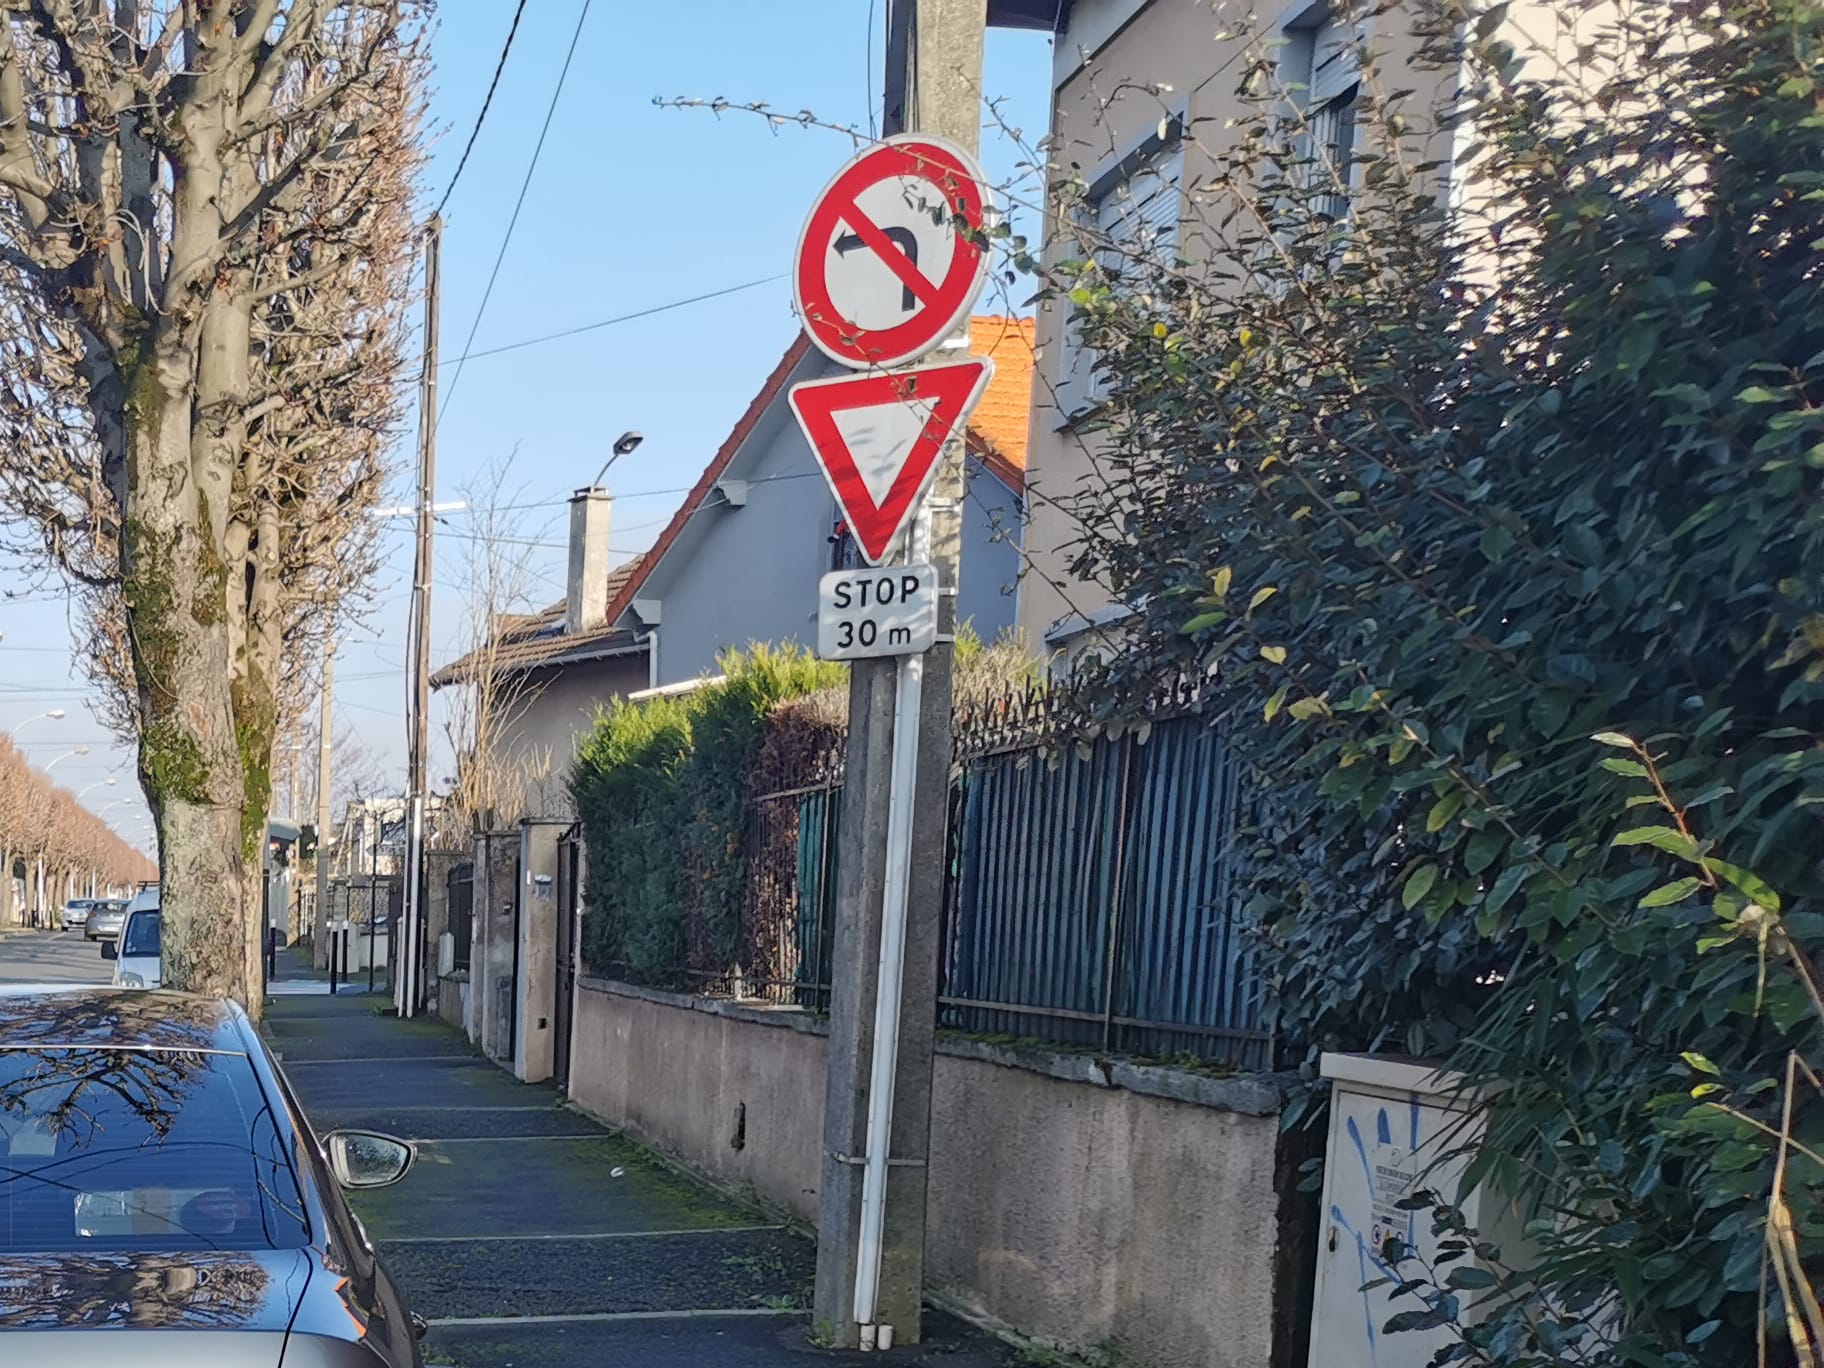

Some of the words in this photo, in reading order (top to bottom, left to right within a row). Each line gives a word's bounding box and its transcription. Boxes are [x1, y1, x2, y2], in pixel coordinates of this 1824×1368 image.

[833, 575, 920, 609] STOP
[837, 619, 877, 649] 30
[888, 626, 911, 645] m
